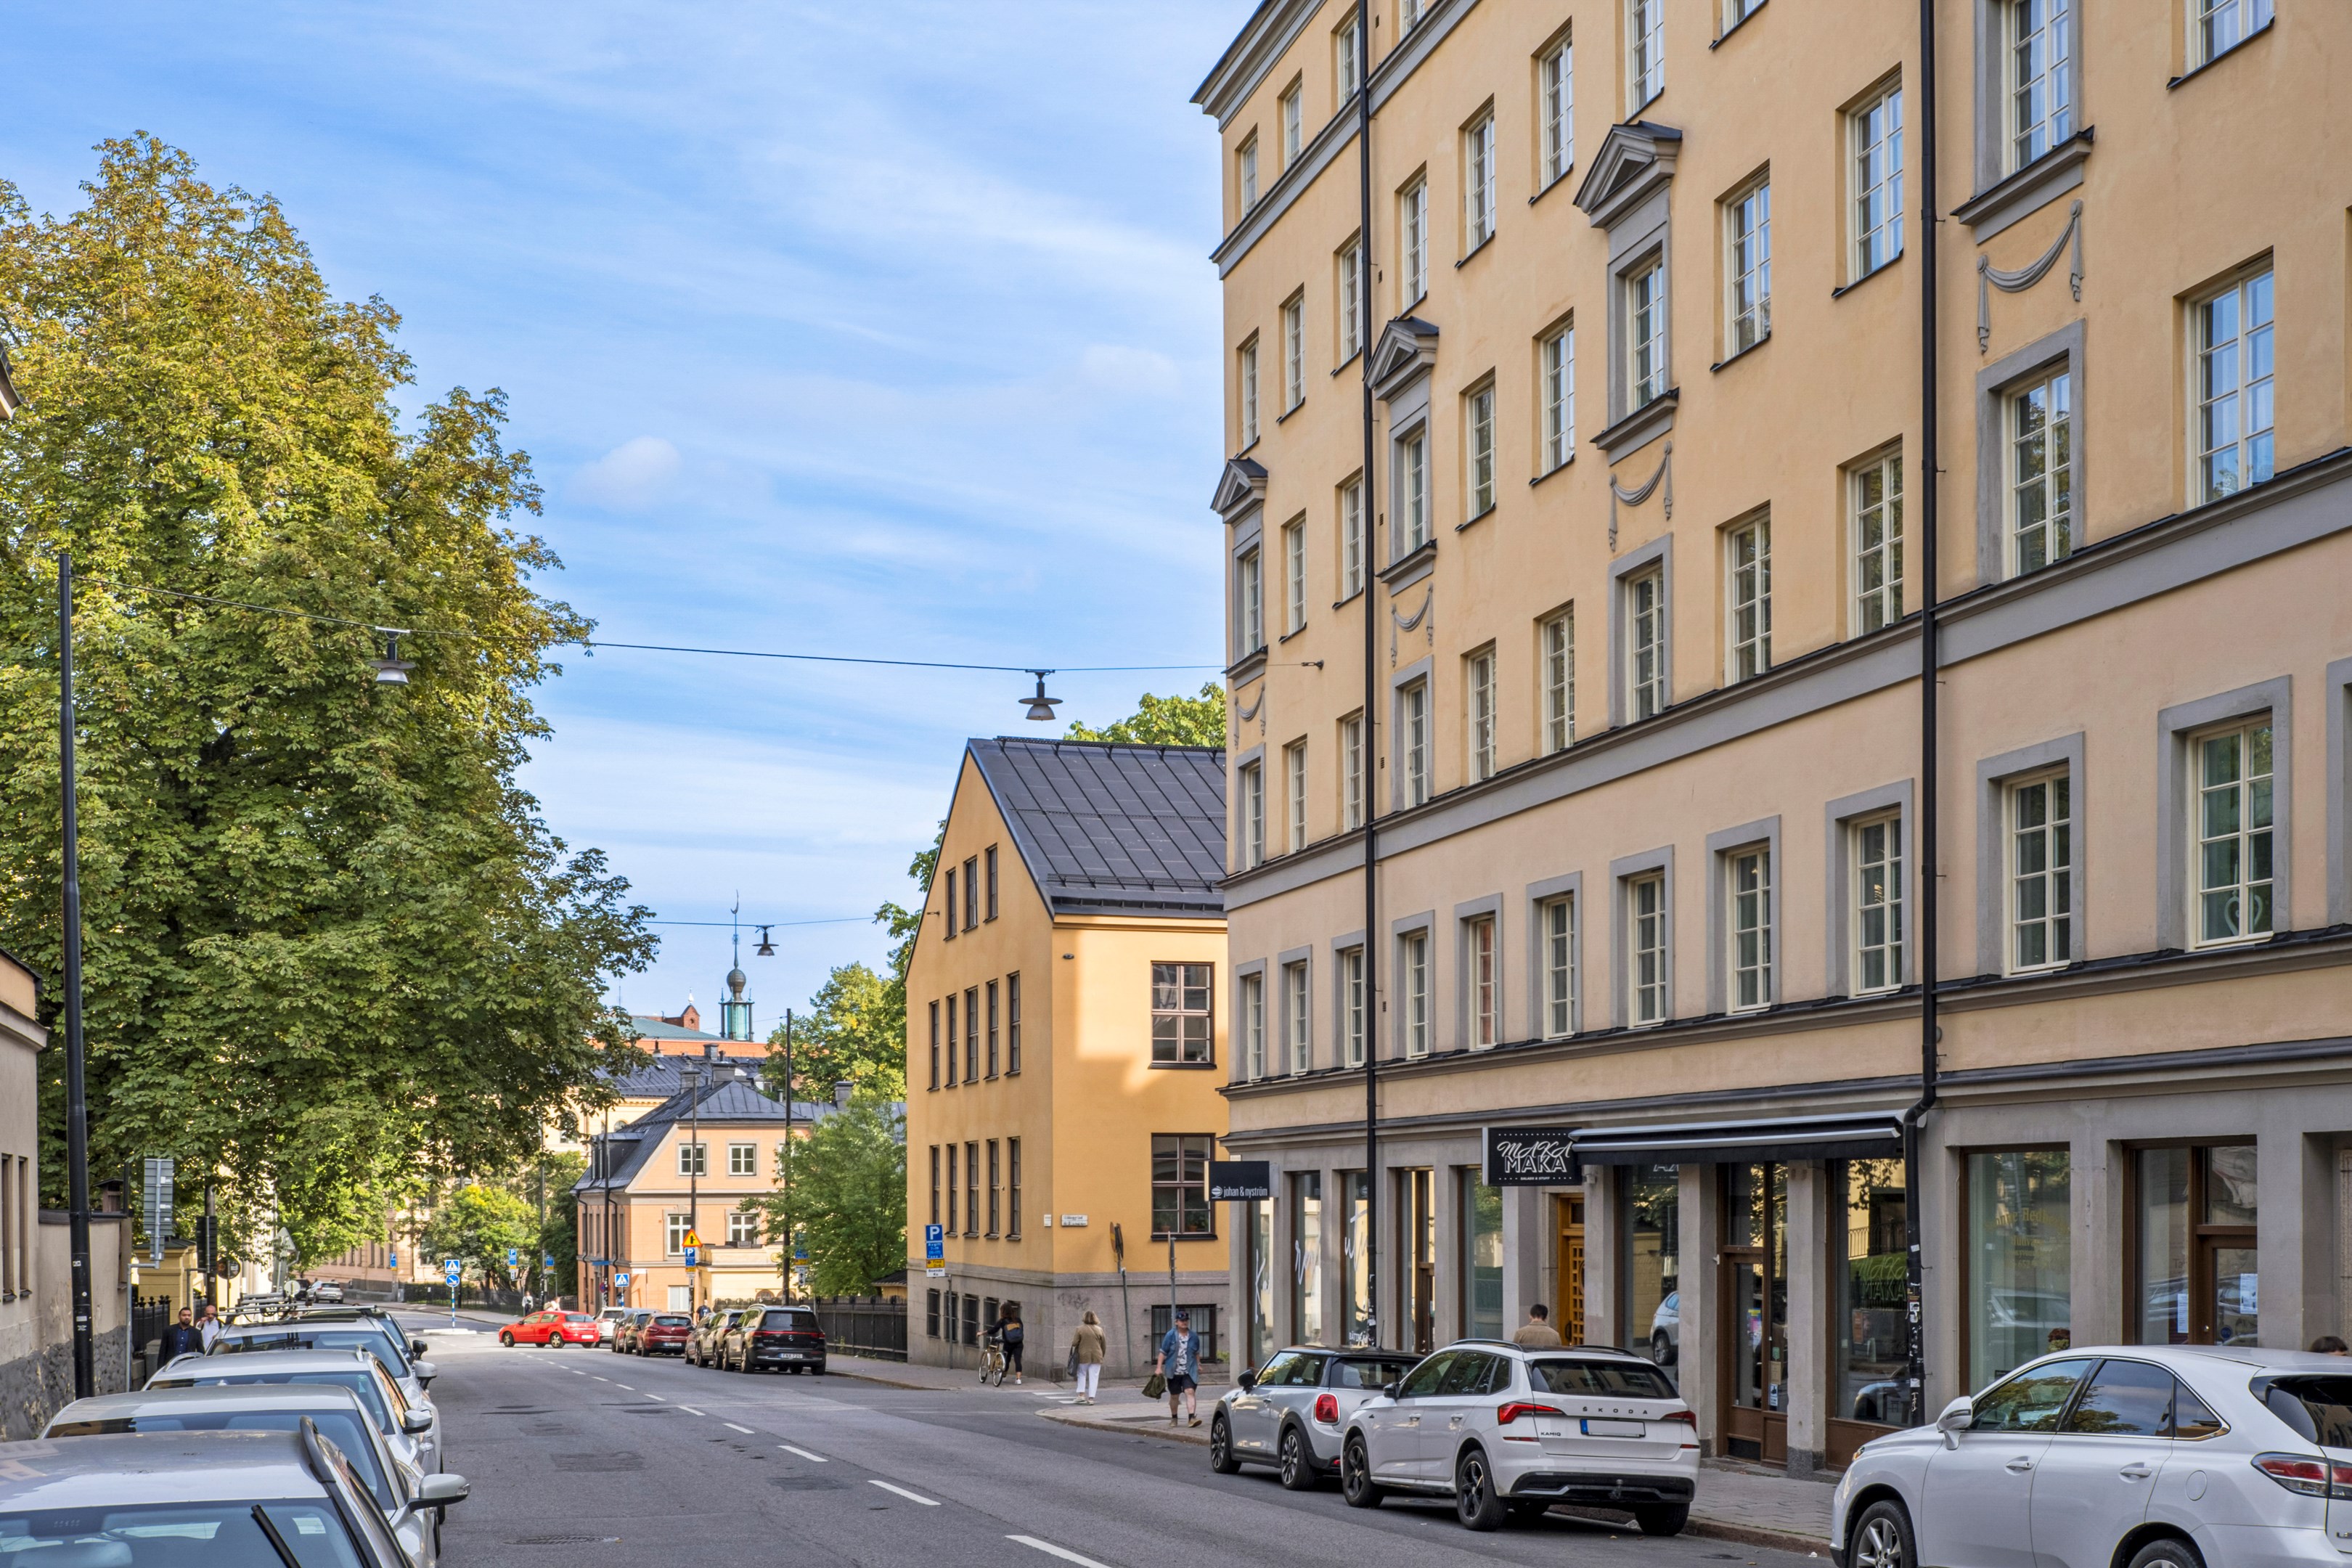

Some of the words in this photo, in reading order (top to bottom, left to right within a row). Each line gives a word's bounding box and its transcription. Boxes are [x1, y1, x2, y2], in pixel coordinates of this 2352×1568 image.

[1504, 1155, 1567, 1173] MAKA
[1223, 1186, 1239, 1198] johan
[1239, 1186, 1245, 1197] &
[1245, 1186, 1268, 1199] nyström
[929, 1225, 940, 1240] P
